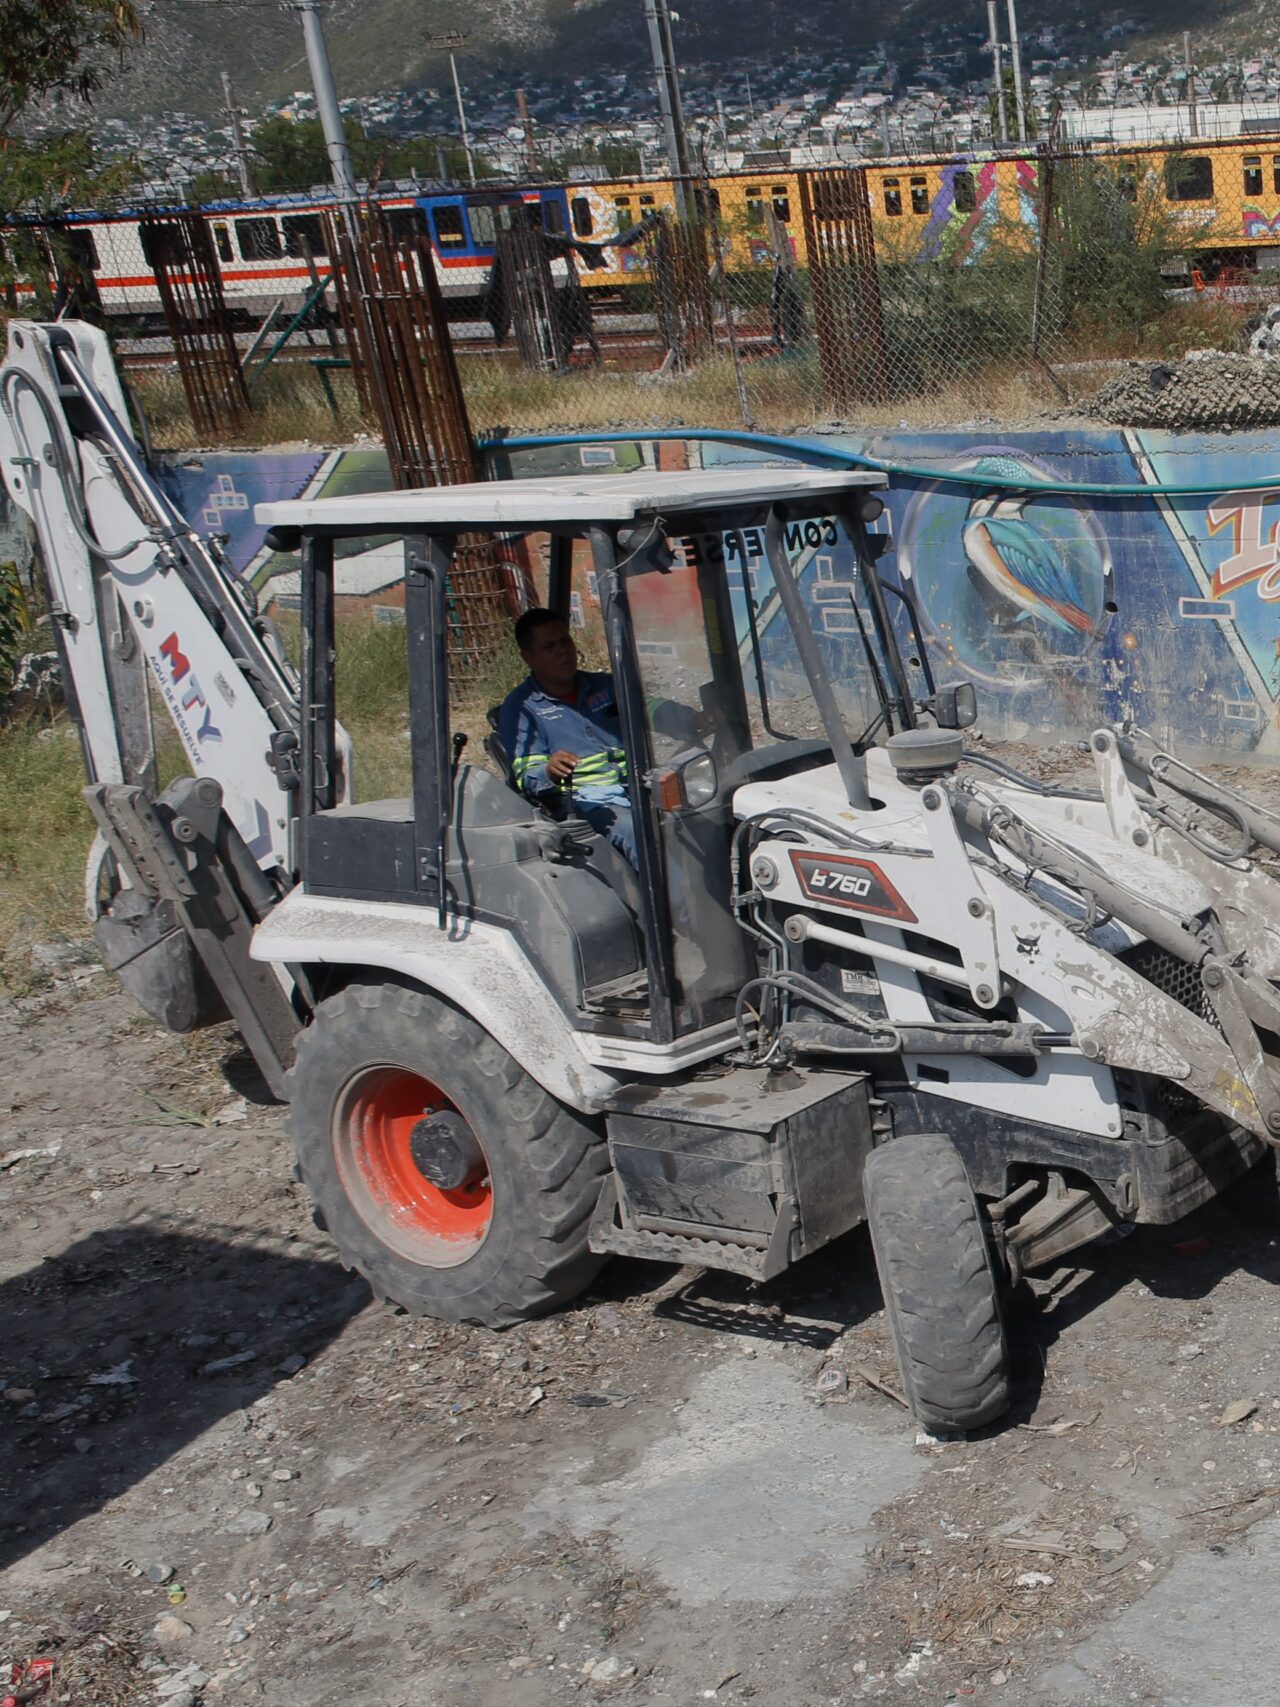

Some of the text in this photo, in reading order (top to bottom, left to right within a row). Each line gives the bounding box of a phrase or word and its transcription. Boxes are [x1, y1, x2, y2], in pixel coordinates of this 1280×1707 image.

[150, 655, 204, 766] AQUÍ SE RESUELVE
[160, 631, 223, 744] MTY
